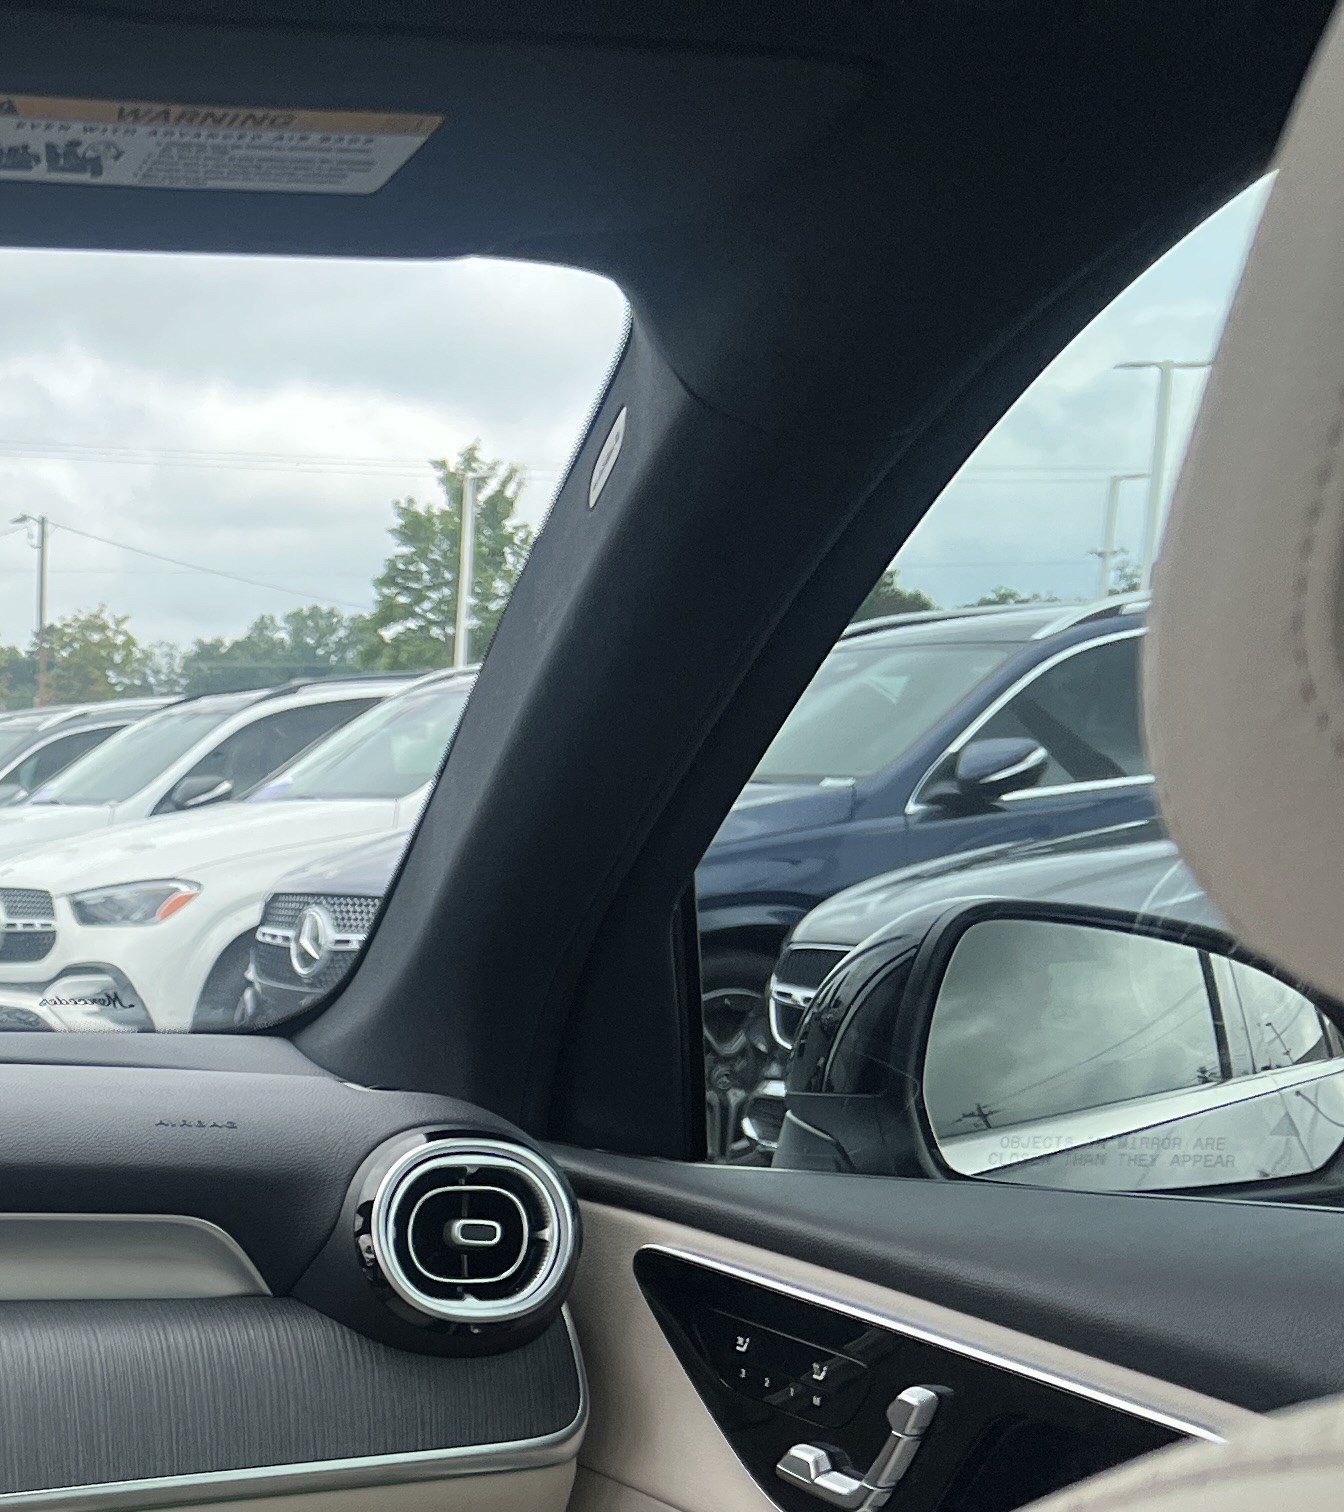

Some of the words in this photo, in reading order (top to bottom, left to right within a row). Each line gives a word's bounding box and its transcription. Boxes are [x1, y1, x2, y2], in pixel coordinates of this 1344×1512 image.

[116, 105, 297, 128] WARNING
[1000, 1135, 1074, 1150] OBJECTS
[1119, 1136, 1183, 1151] MIRROR
[1193, 1136, 1226, 1150] ARE
[1064, 1153, 1106, 1167] THAN
[1118, 1153, 1159, 1168] THEY
[1170, 1153, 1235, 1169] APPEAR
